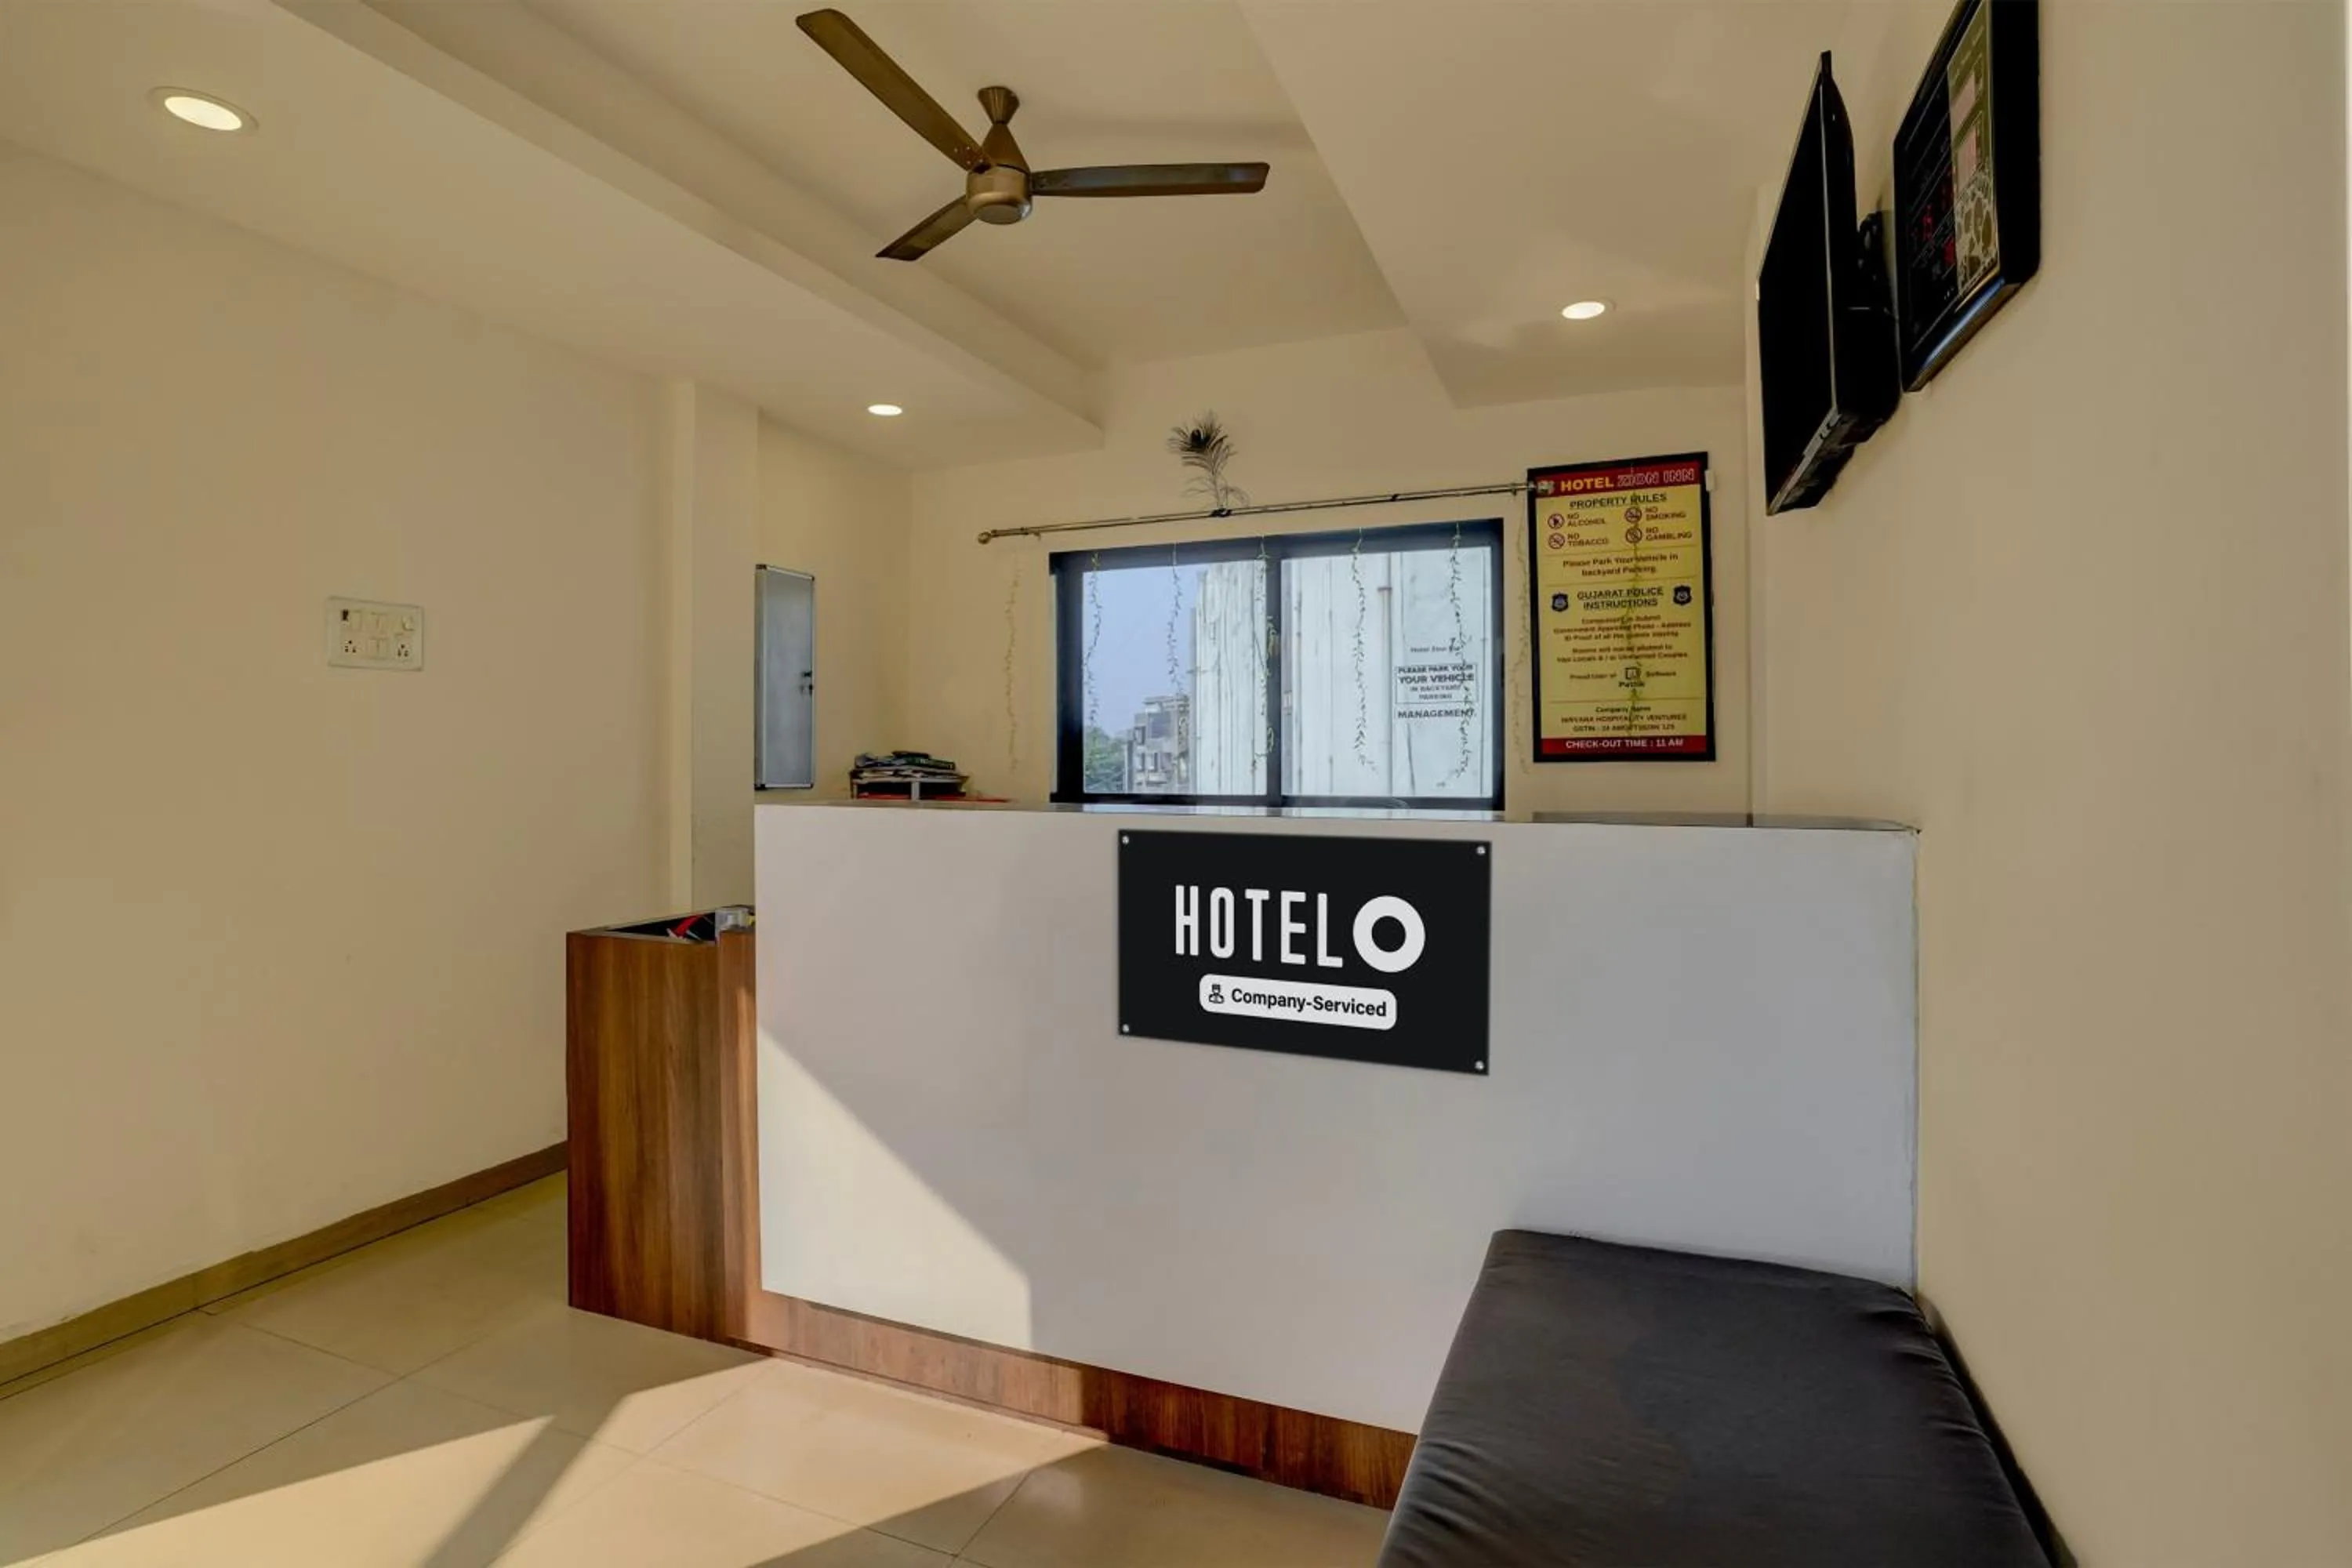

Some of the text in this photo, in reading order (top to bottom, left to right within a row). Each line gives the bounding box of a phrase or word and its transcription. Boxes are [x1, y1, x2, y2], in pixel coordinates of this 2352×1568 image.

[1560, 477, 1614, 492] HOTEL
[1569, 492, 1667, 509] PROPERTY RULES
[1577, 586, 1664, 601] GUJARAT POLICE
[1583, 598, 1658, 611] INSTRUCTIONS
[1399, 673, 1475, 684] YOUR VEHICLE
[1398, 708, 1475, 720] MANAGEMENT
[1566, 740, 1623, 750] CHECK-OUT
[1624, 739, 1648, 748] TIME
[1668, 738, 1684, 746] AM
[1175, 884, 1343, 968] HOTEL
[1231, 988, 1387, 1018] Company-Serviced
